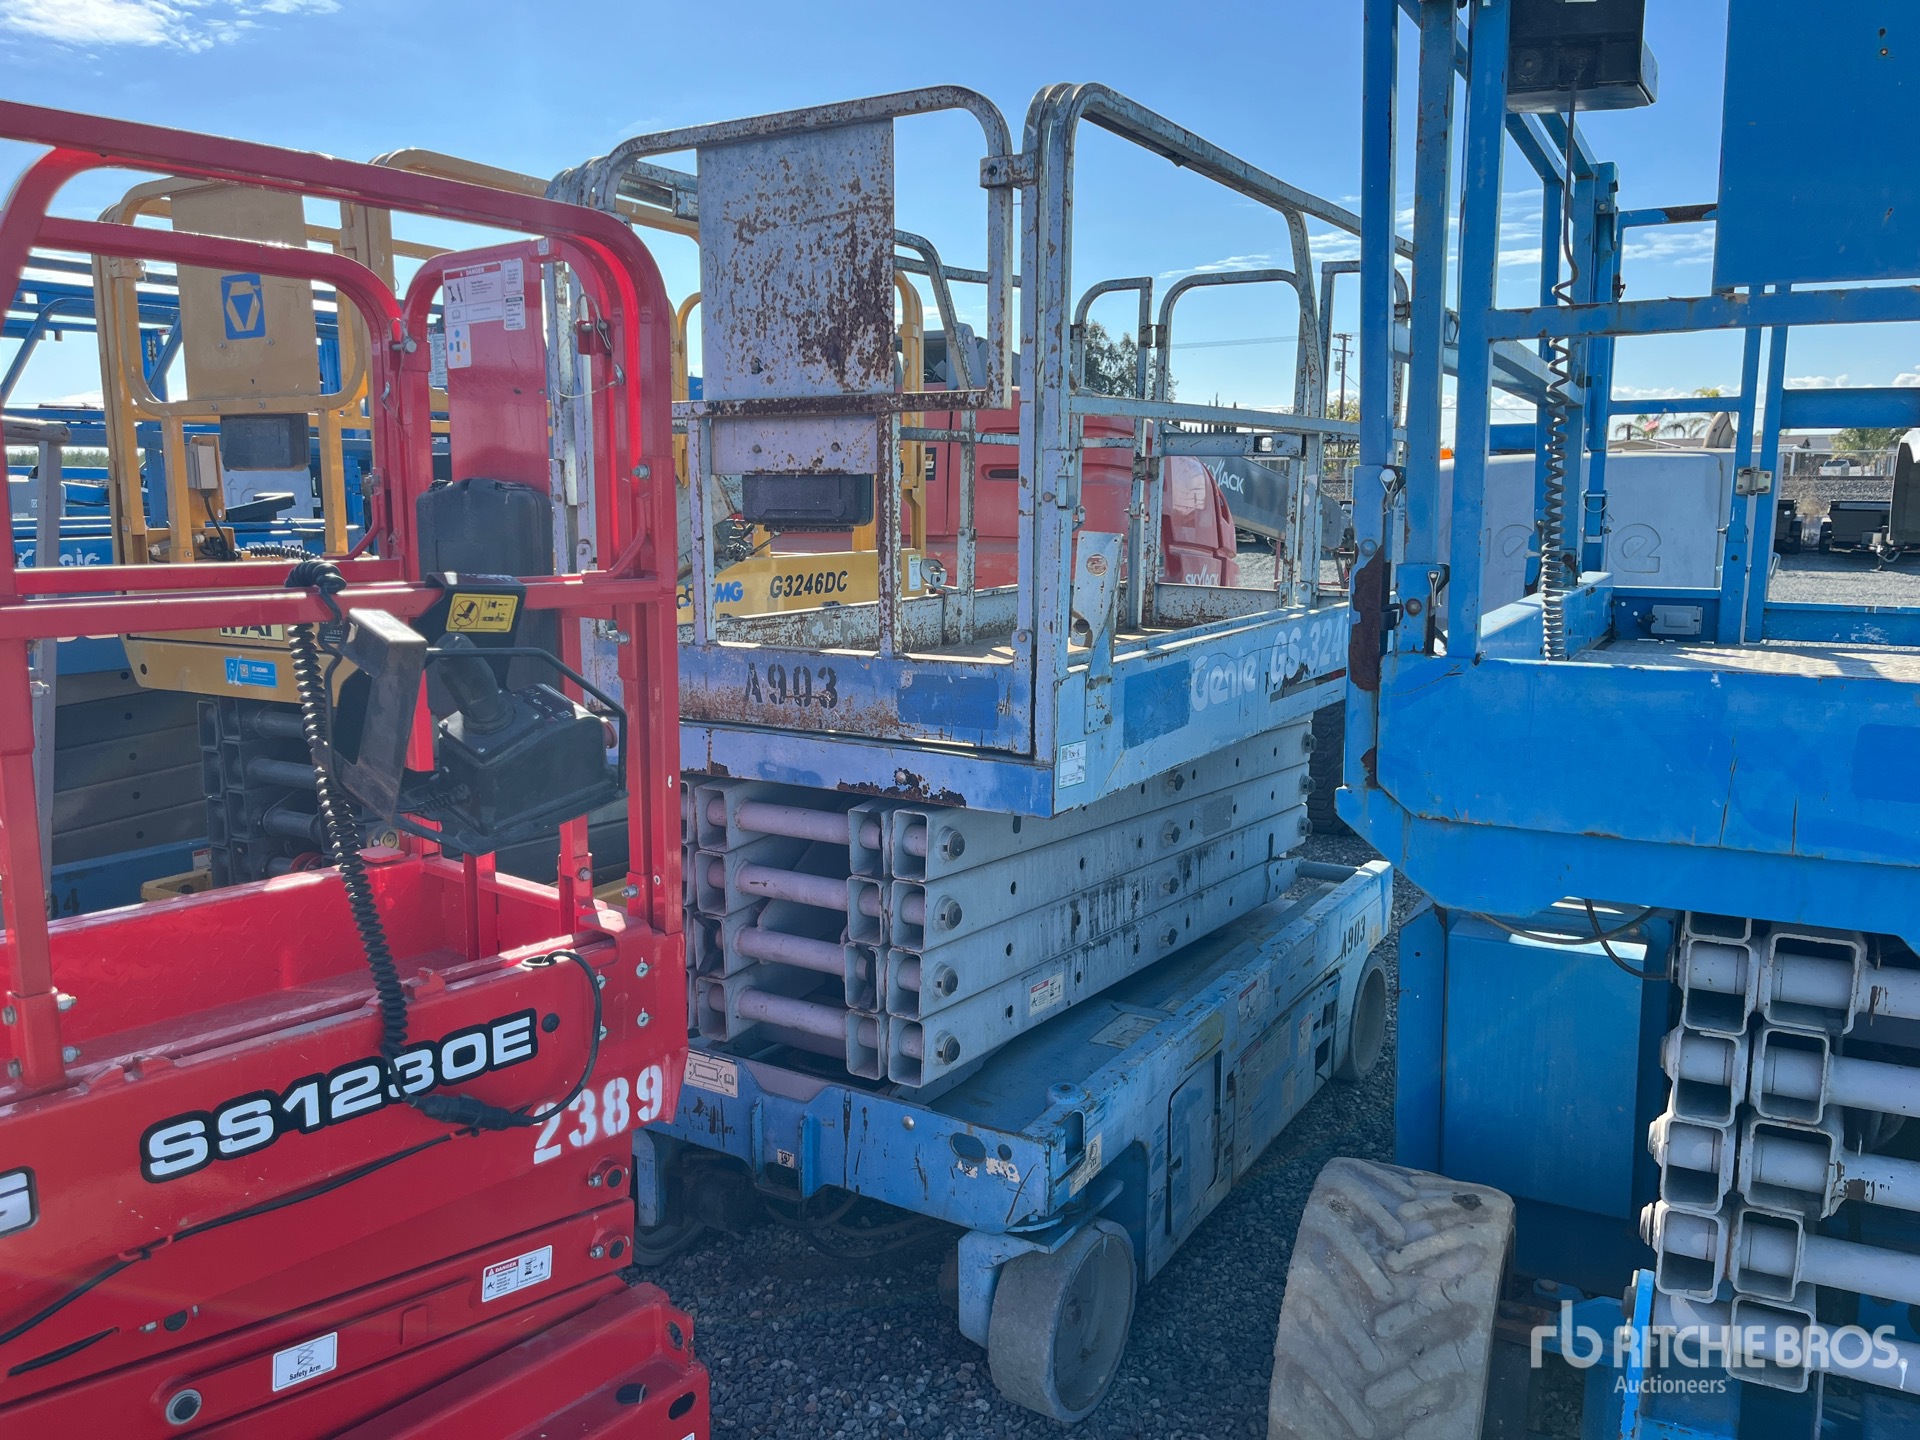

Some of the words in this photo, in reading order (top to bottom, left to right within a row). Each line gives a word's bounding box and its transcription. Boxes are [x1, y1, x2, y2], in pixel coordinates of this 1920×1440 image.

[465, 266, 485, 277] DANGER
[769, 570, 848, 599] G3246DC
[744, 662, 838, 709] A903
[1341, 914, 1366, 960] A903
[148, 1016, 533, 1177] SS1230E
[532, 1065, 663, 1165] 2389
[495, 1261, 517, 1273] DANGER
[289, 1370, 308, 1381] Safety
[309, 1364, 321, 1374] Arm
